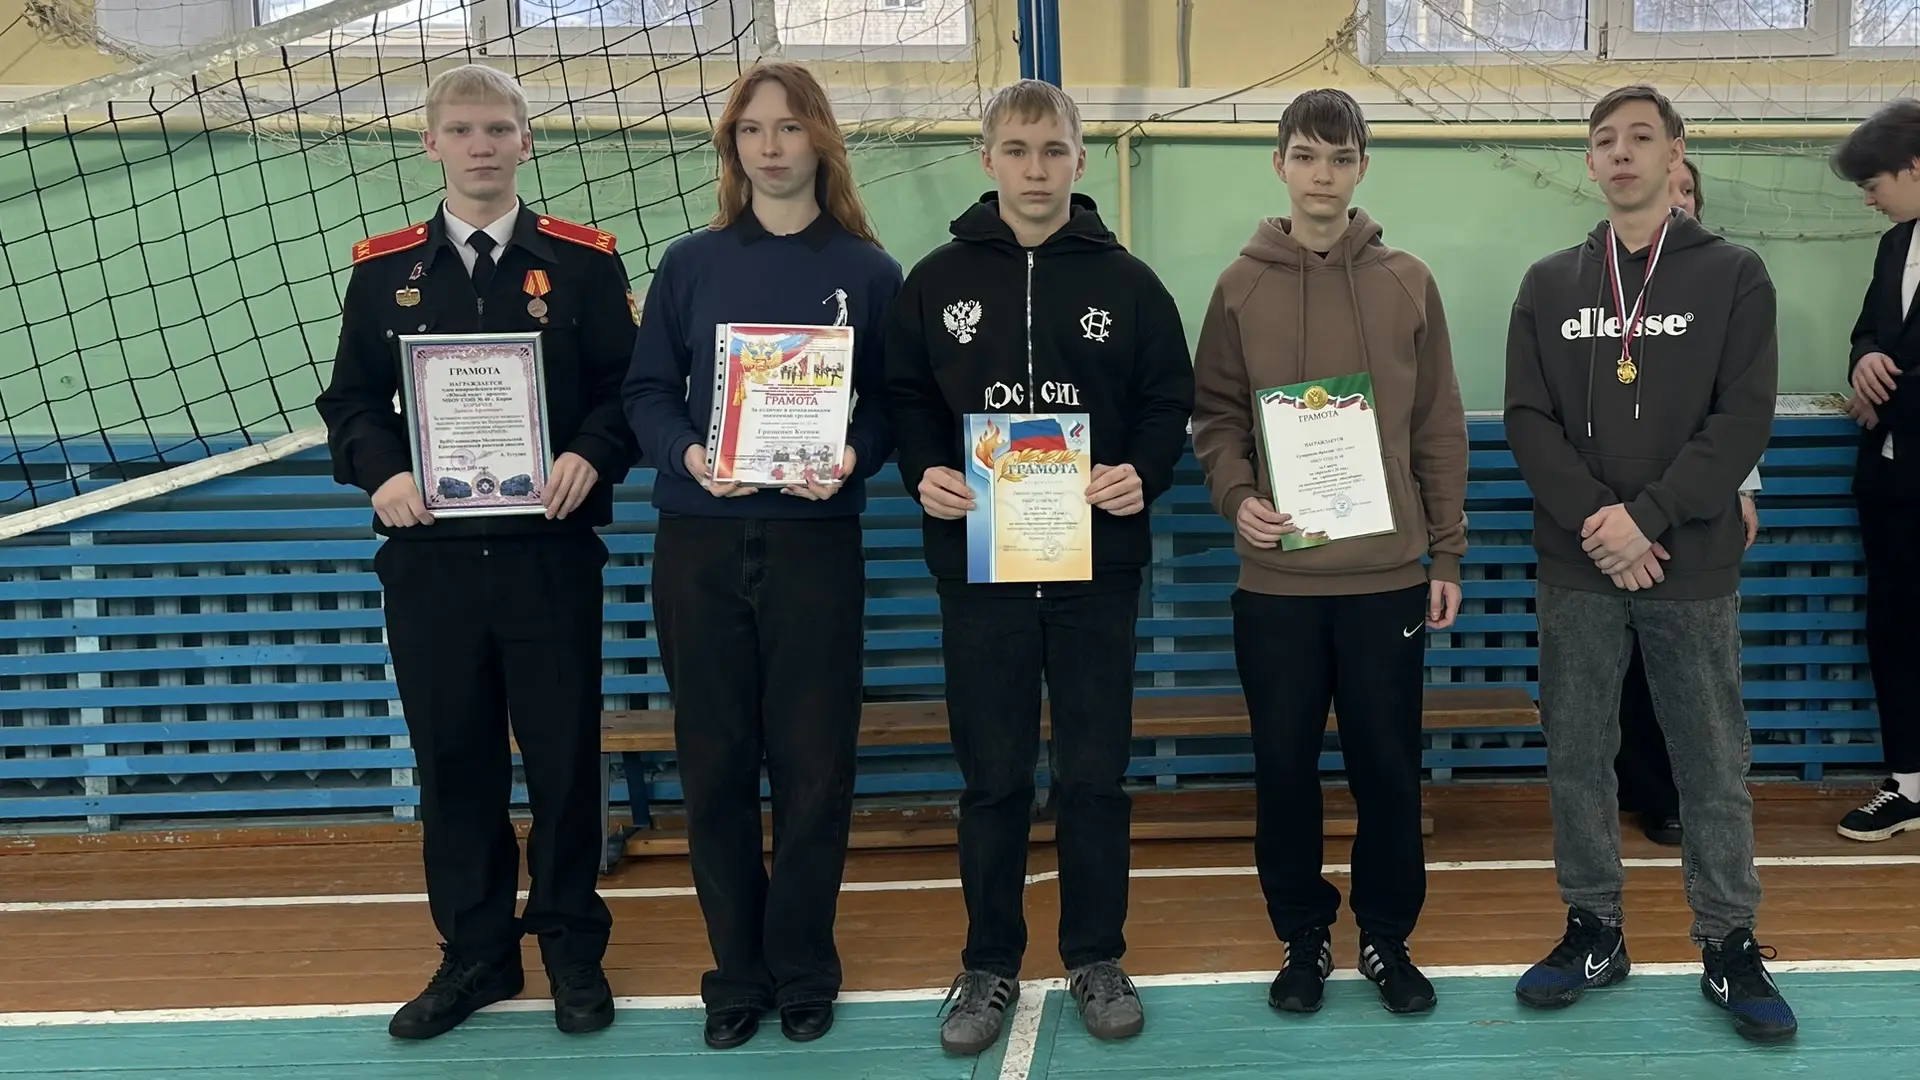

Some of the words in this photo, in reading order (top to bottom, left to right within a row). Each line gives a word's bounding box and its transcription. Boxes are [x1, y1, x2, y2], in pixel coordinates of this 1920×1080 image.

[449, 367, 501, 376] ГРАМОТА
[765, 396, 818, 405] ГРАМОТА
[1298, 410, 1339, 423] ГРАМОТА
[1008, 463, 1079, 475] ГРАМОТА
